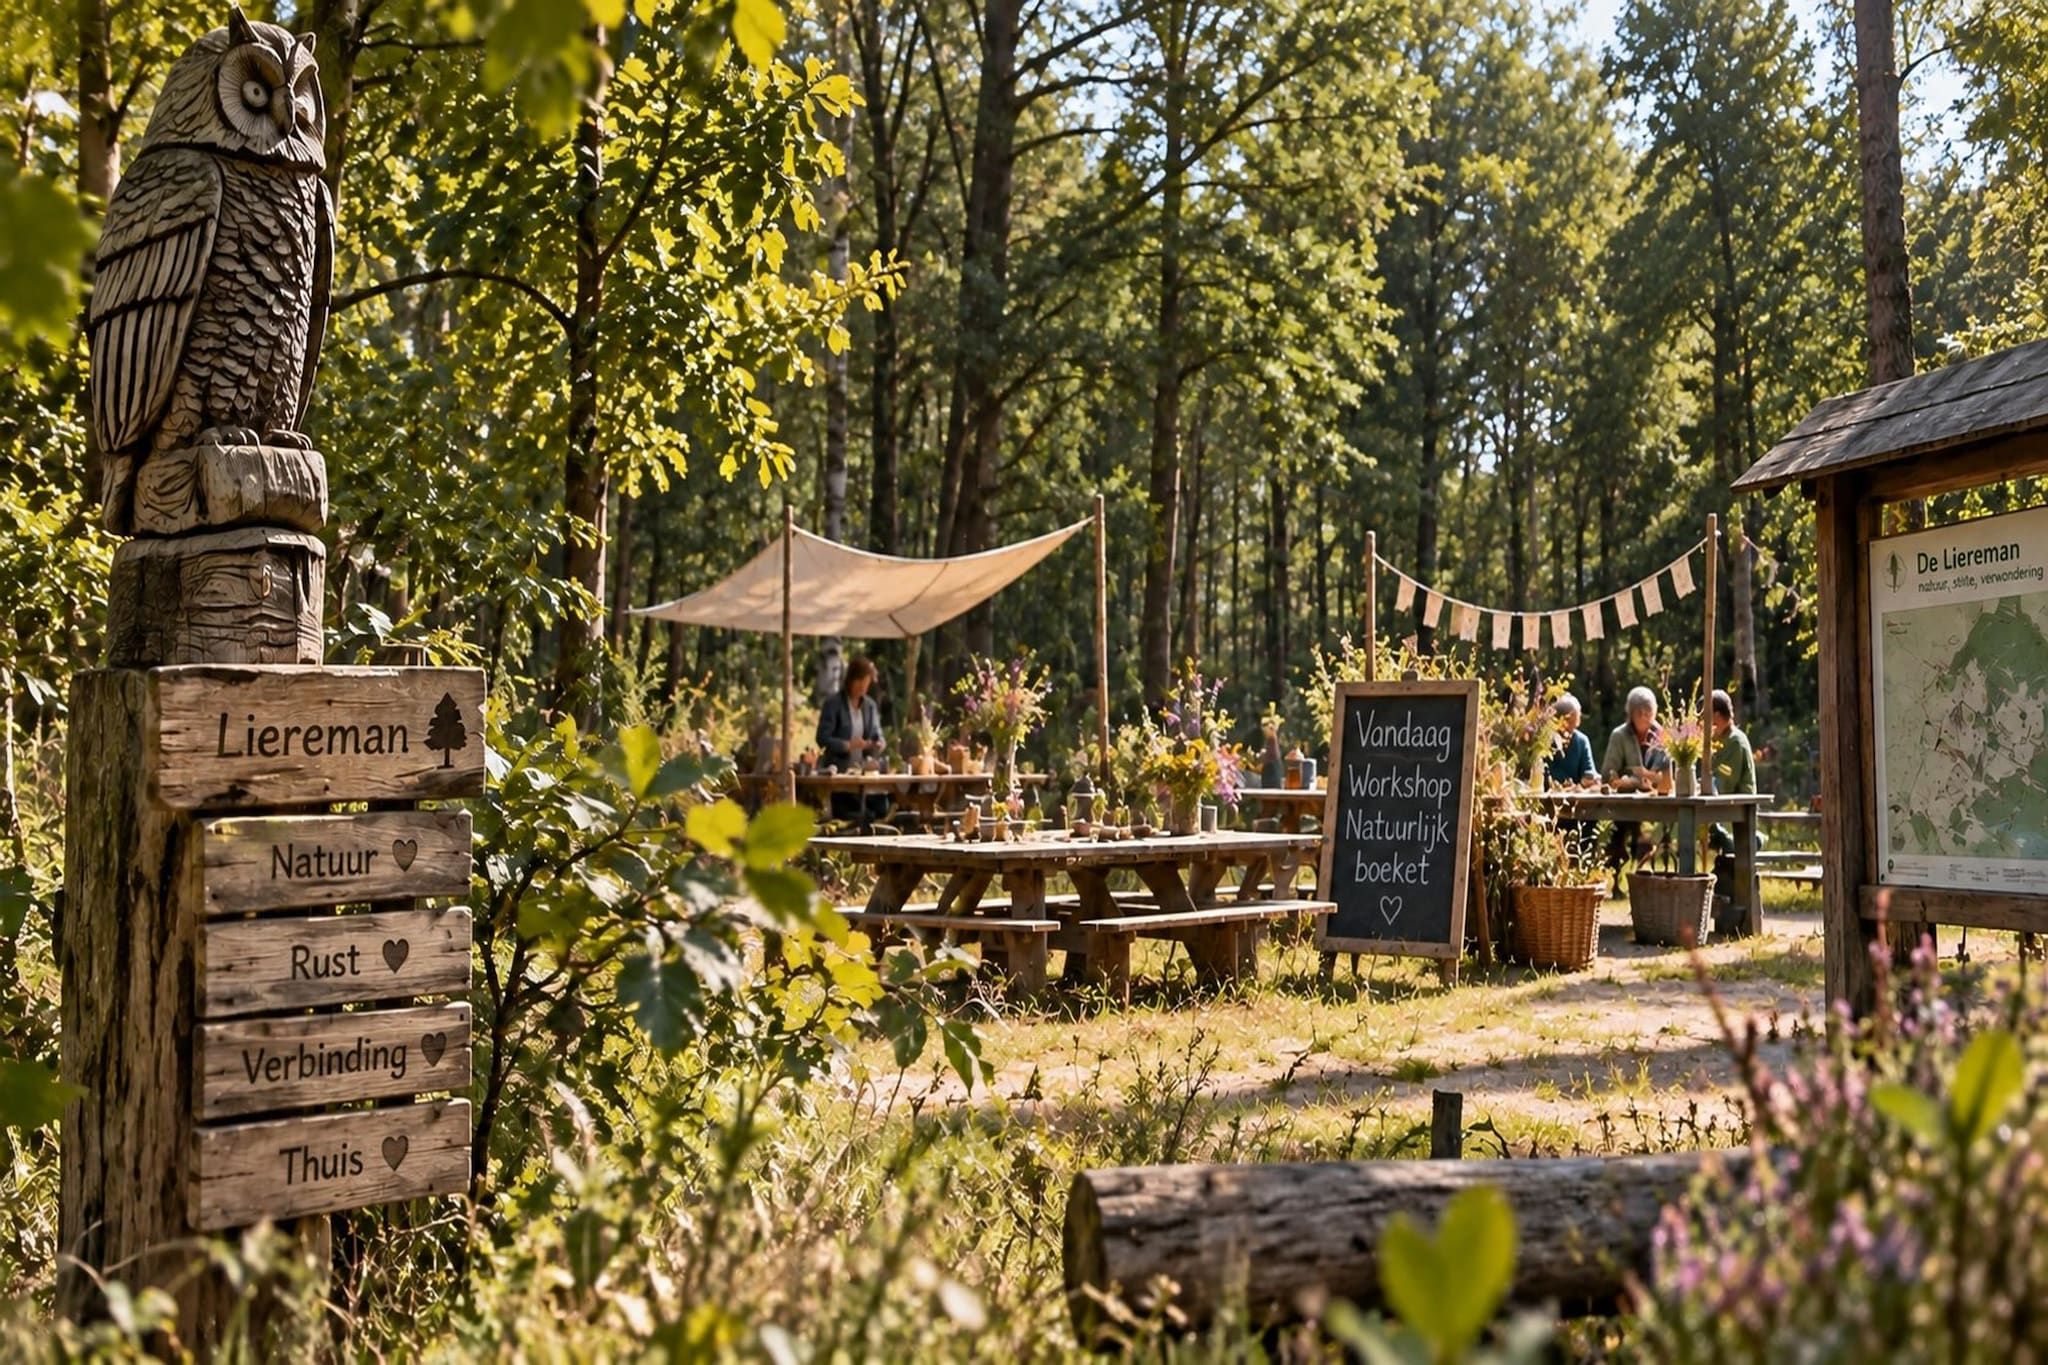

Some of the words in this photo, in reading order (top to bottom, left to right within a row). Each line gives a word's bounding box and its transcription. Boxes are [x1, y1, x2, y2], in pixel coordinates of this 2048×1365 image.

[1917, 552, 1938, 574] De
[1943, 543, 2020, 570] Liereman
[1980, 565, 2044, 585] verwondering
[216, 713, 409, 758] Liereman
[1356, 709, 1451, 763] Vandaag
[1349, 763, 1451, 809] Workshop
[1346, 808, 1449, 853] Natuurlijk
[271, 843, 378, 880] Natuur
[1355, 850, 1430, 884] boeket
[291, 944, 360, 980] Rust
[242, 1037, 407, 1084] Verbinding
[279, 1143, 364, 1185] Thuis
